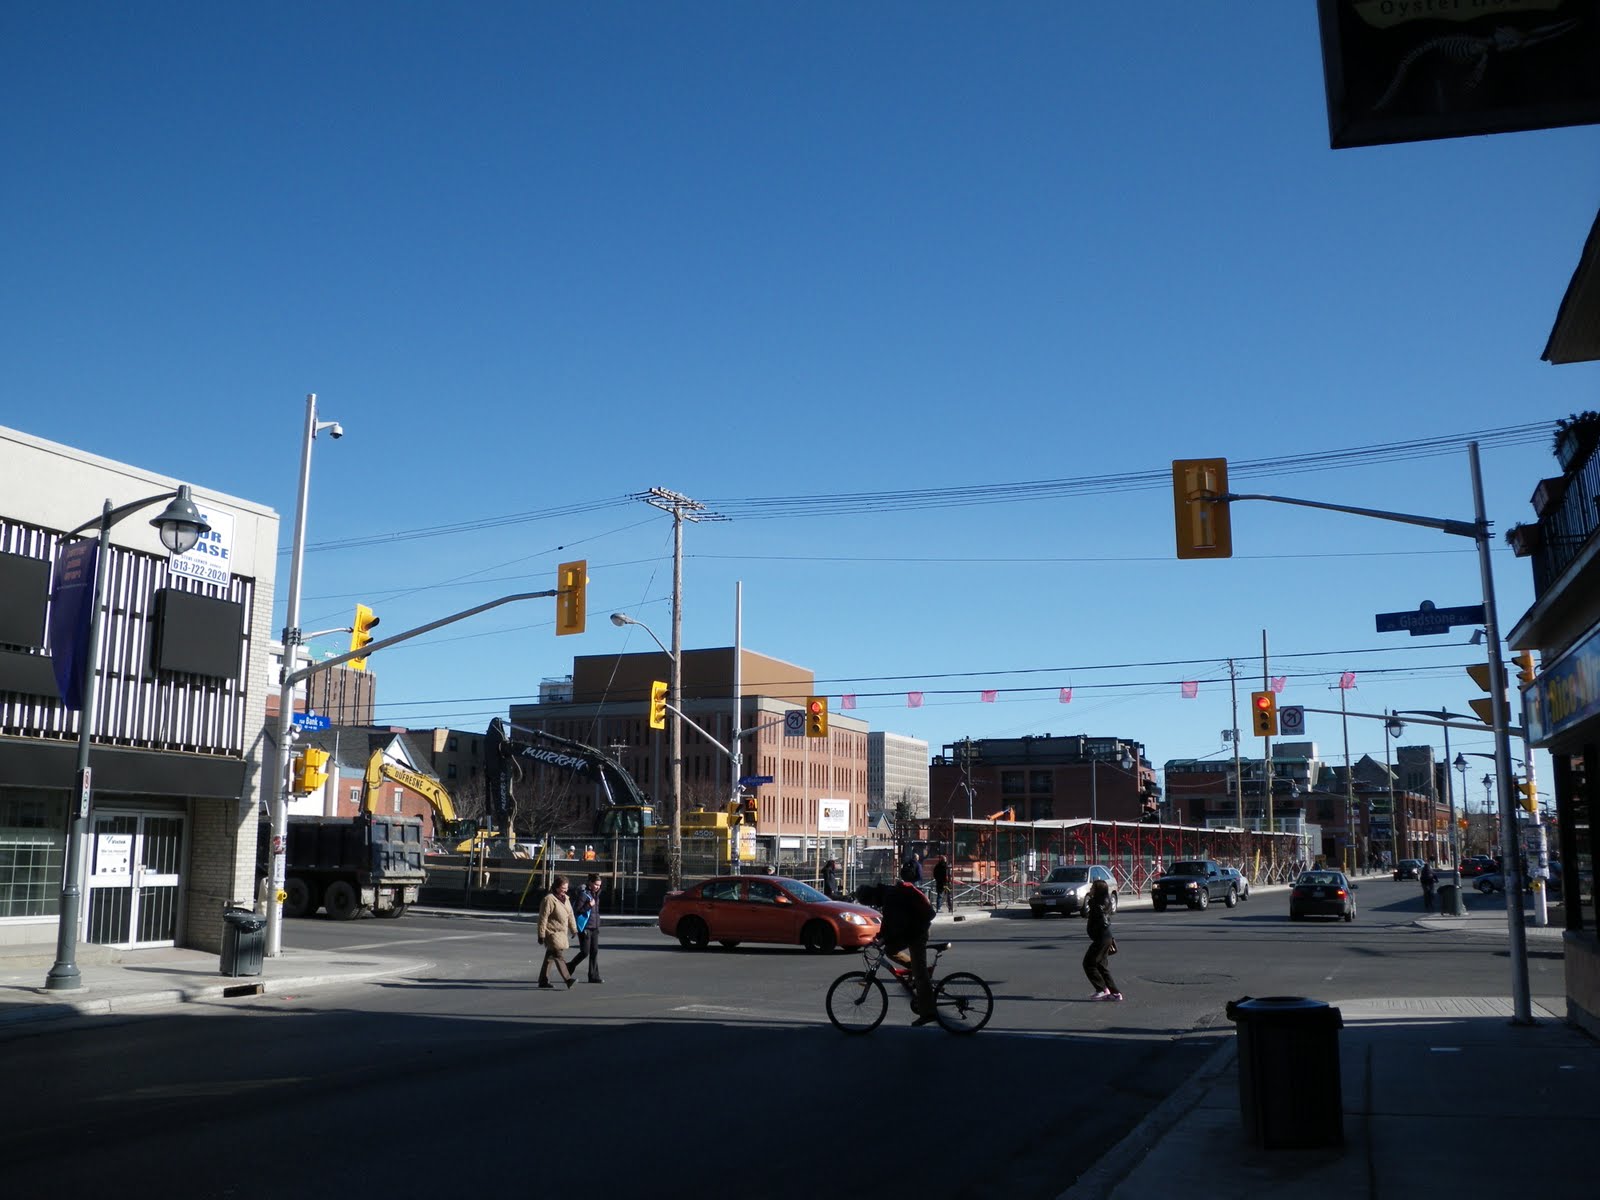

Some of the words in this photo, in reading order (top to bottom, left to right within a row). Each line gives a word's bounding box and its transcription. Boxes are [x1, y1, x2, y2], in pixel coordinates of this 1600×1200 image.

[173, 559, 227, 581] 613-722-2020
[1399, 614, 1455, 628] Gladstone
[522, 746, 588, 771] MURRAY
[394, 770, 424, 791] DUFRESNE
